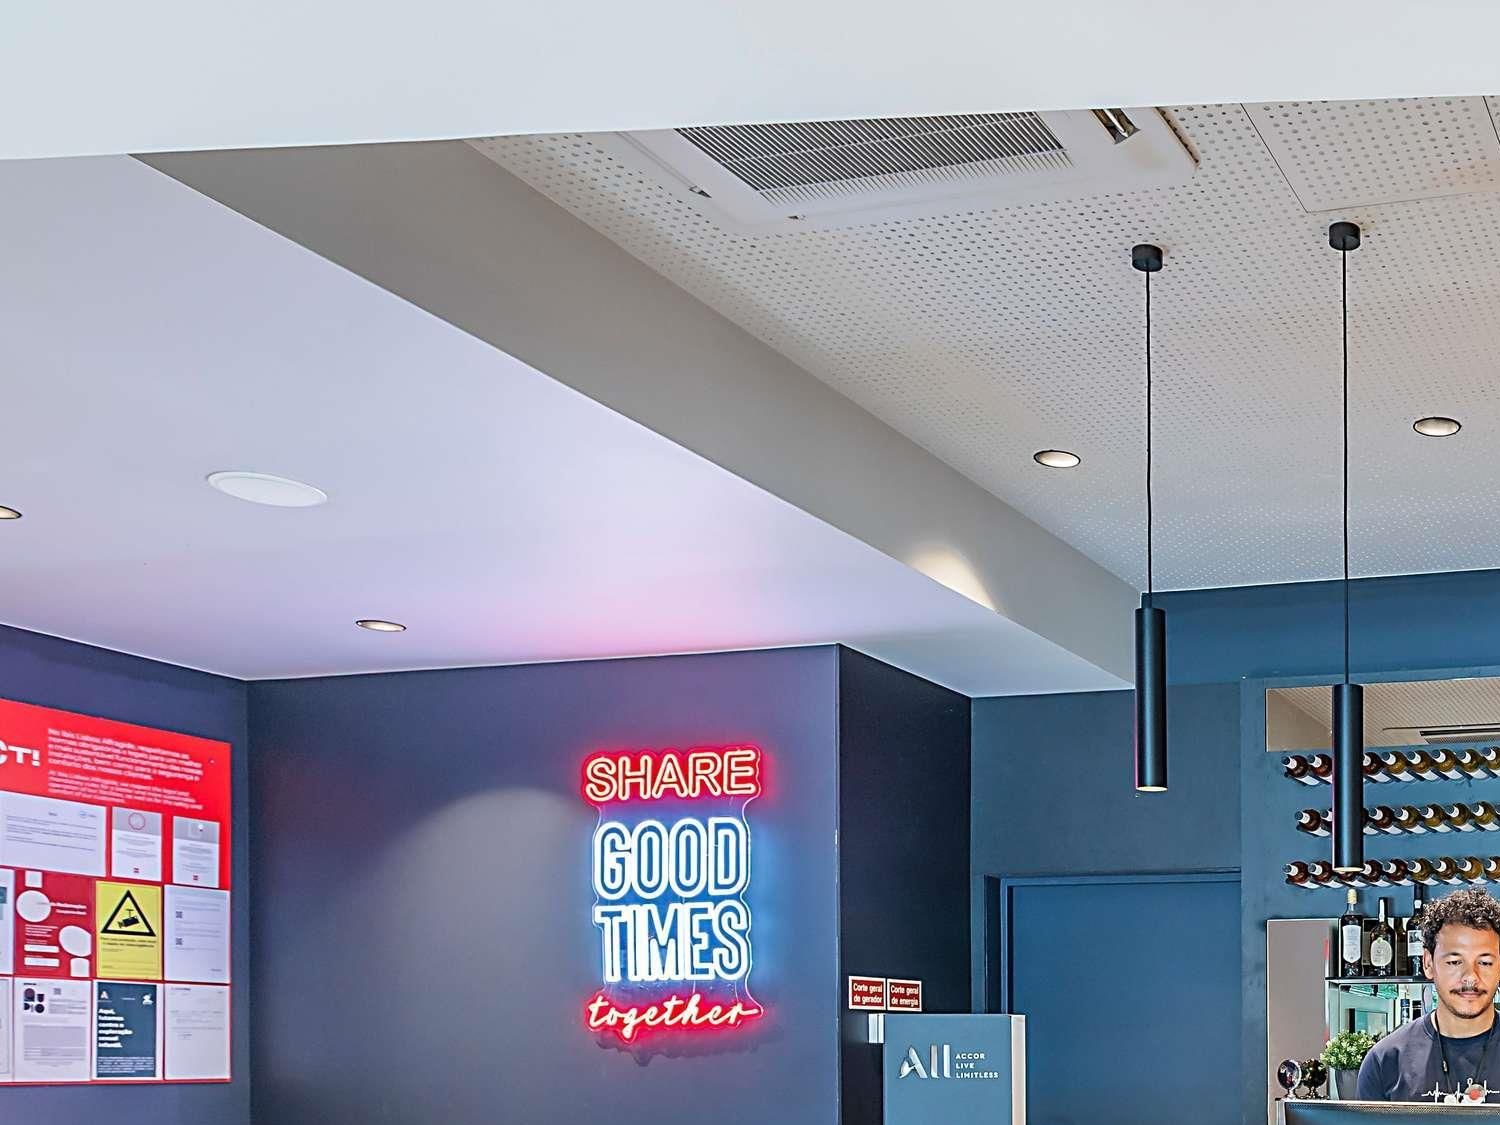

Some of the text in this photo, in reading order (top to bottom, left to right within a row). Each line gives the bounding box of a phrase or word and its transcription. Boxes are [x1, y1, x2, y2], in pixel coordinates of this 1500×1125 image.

[587, 750, 756, 801] SHARE
[594, 818, 747, 899] GOOD
[594, 902, 748, 982] TIMES
[853, 983, 883, 994] Corte geral
[890, 985, 919, 996] Corte geral
[587, 994, 760, 1040] together
